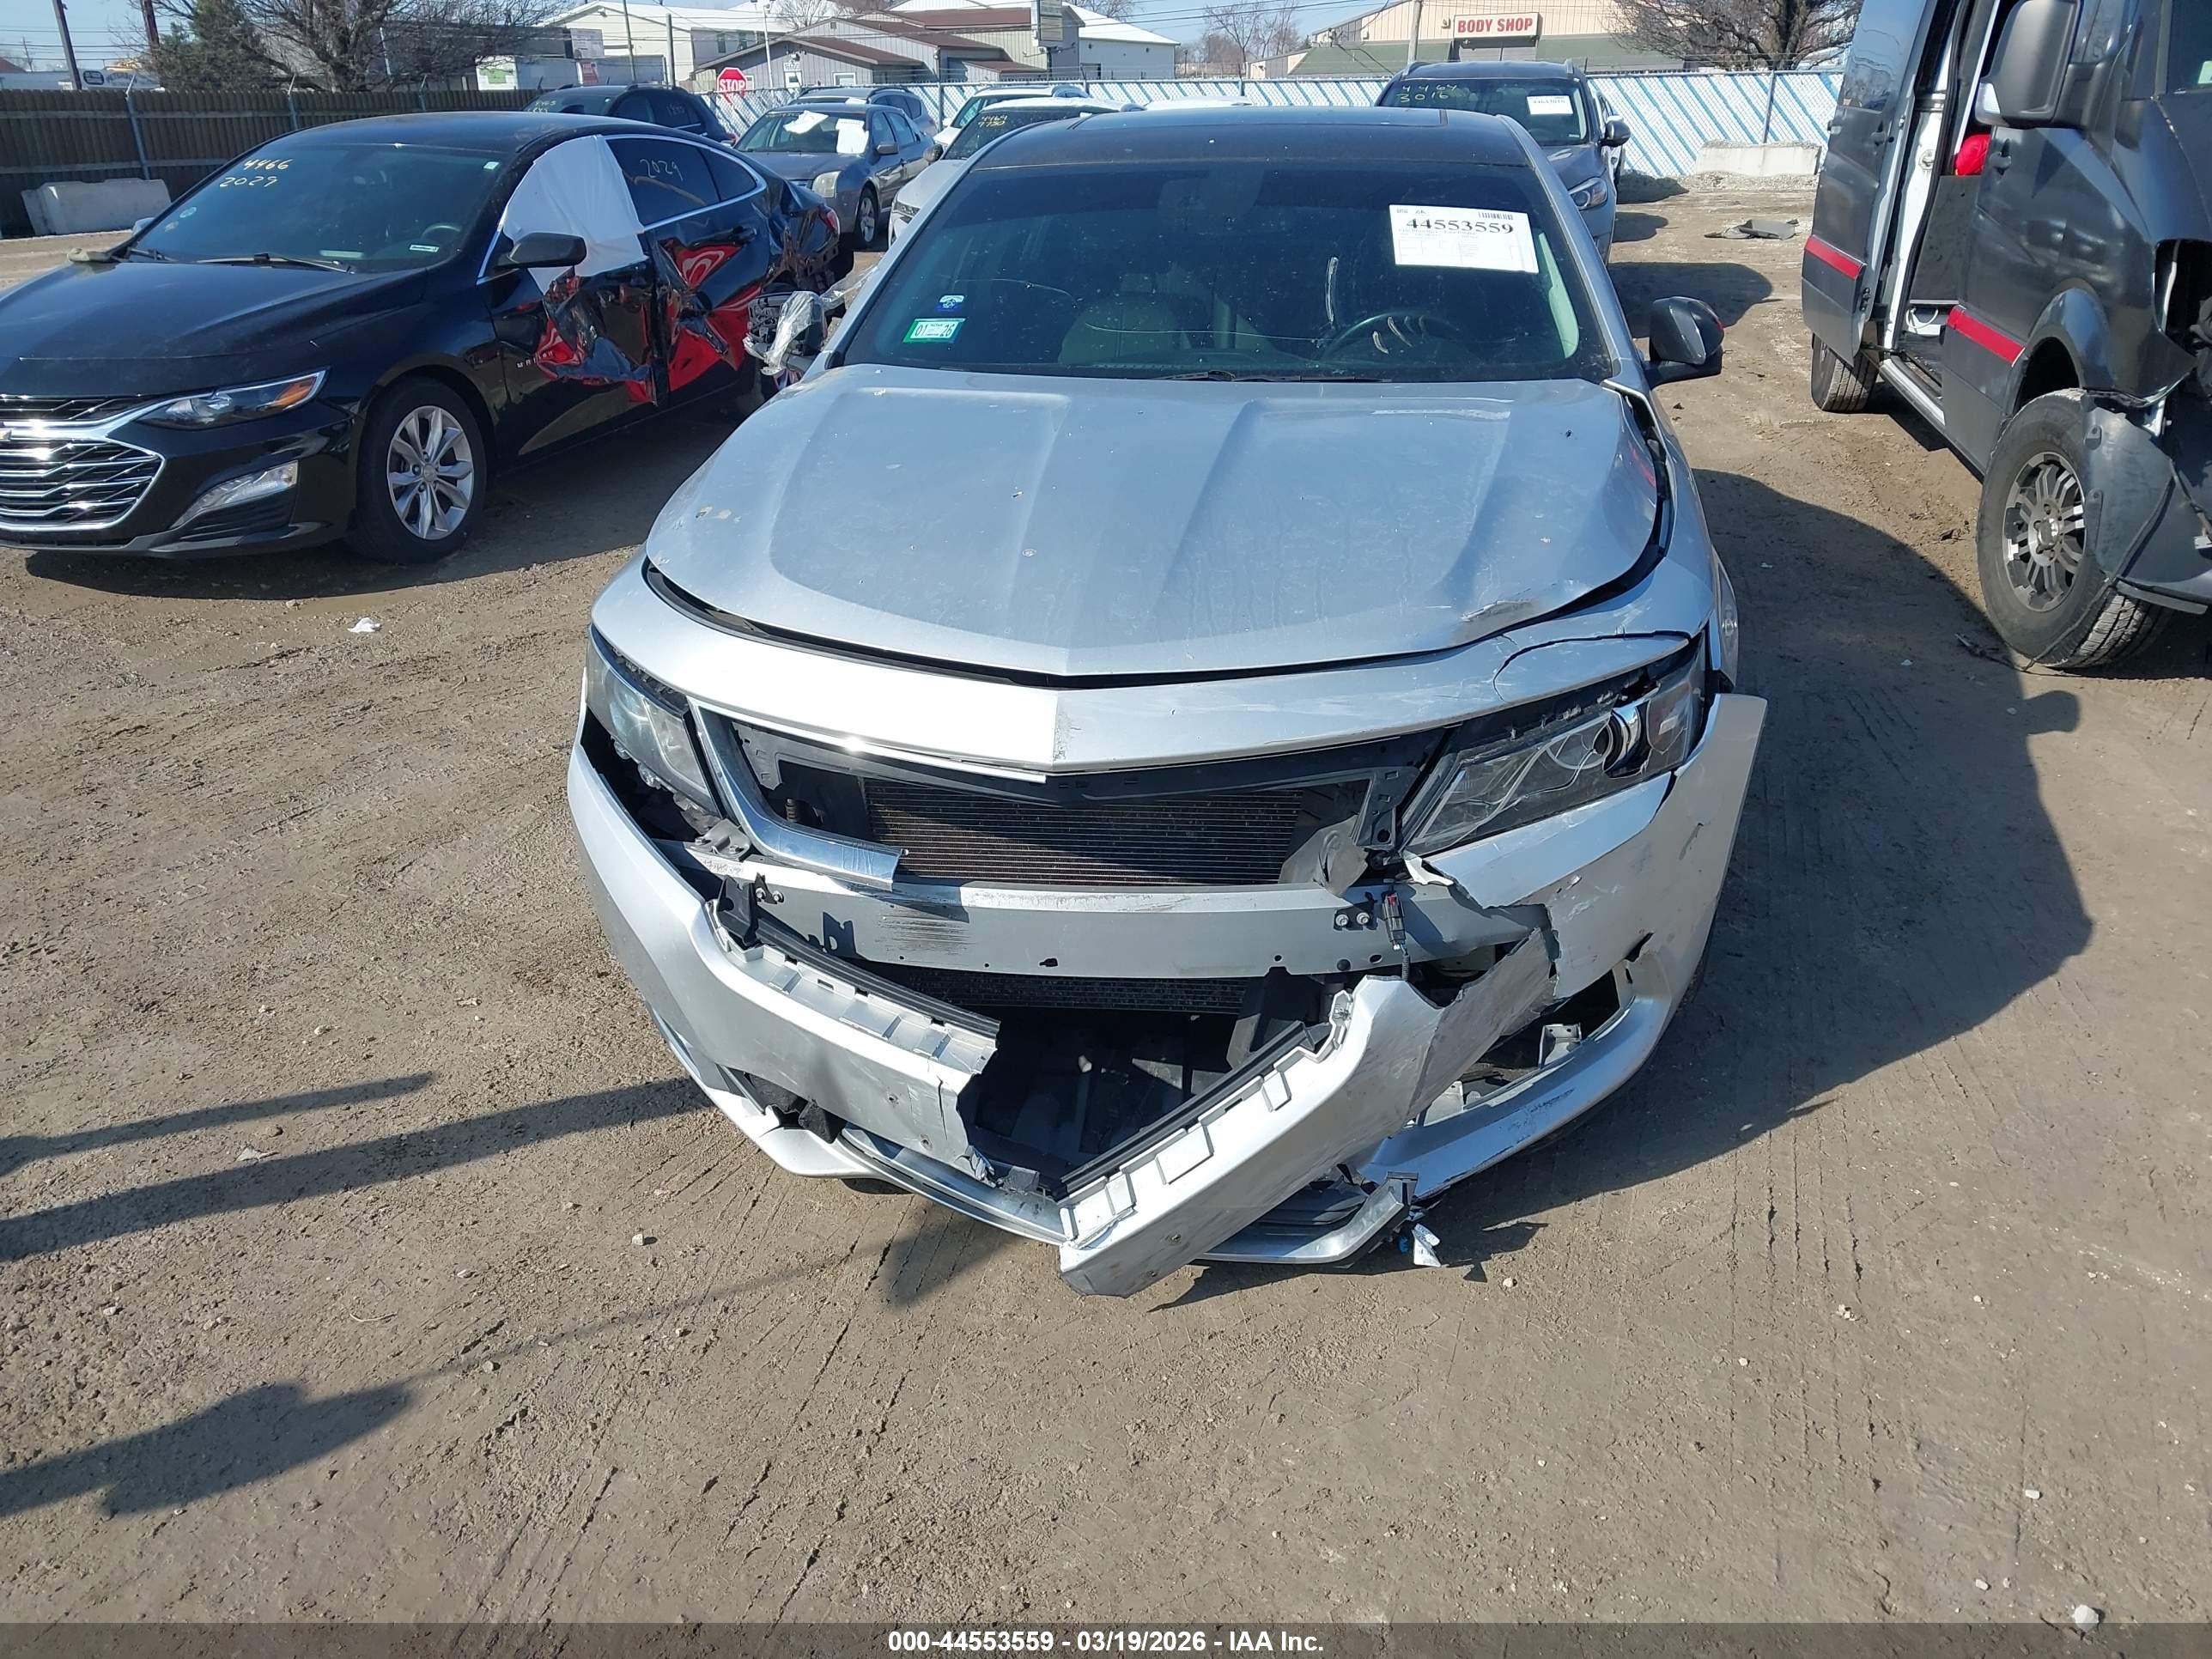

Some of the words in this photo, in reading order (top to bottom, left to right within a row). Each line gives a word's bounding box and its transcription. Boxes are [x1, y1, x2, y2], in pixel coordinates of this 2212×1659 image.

[1457, 18, 1493, 33] BODY
[1497, 17, 1533, 33] SHOP
[720, 78, 745, 92] STOP
[1396, 92, 1449, 102] 3016
[243, 158, 294, 171] 4466
[640, 159, 684, 182] 2029
[219, 175, 278, 187] 2029
[1407, 217, 1515, 234] 44553559
